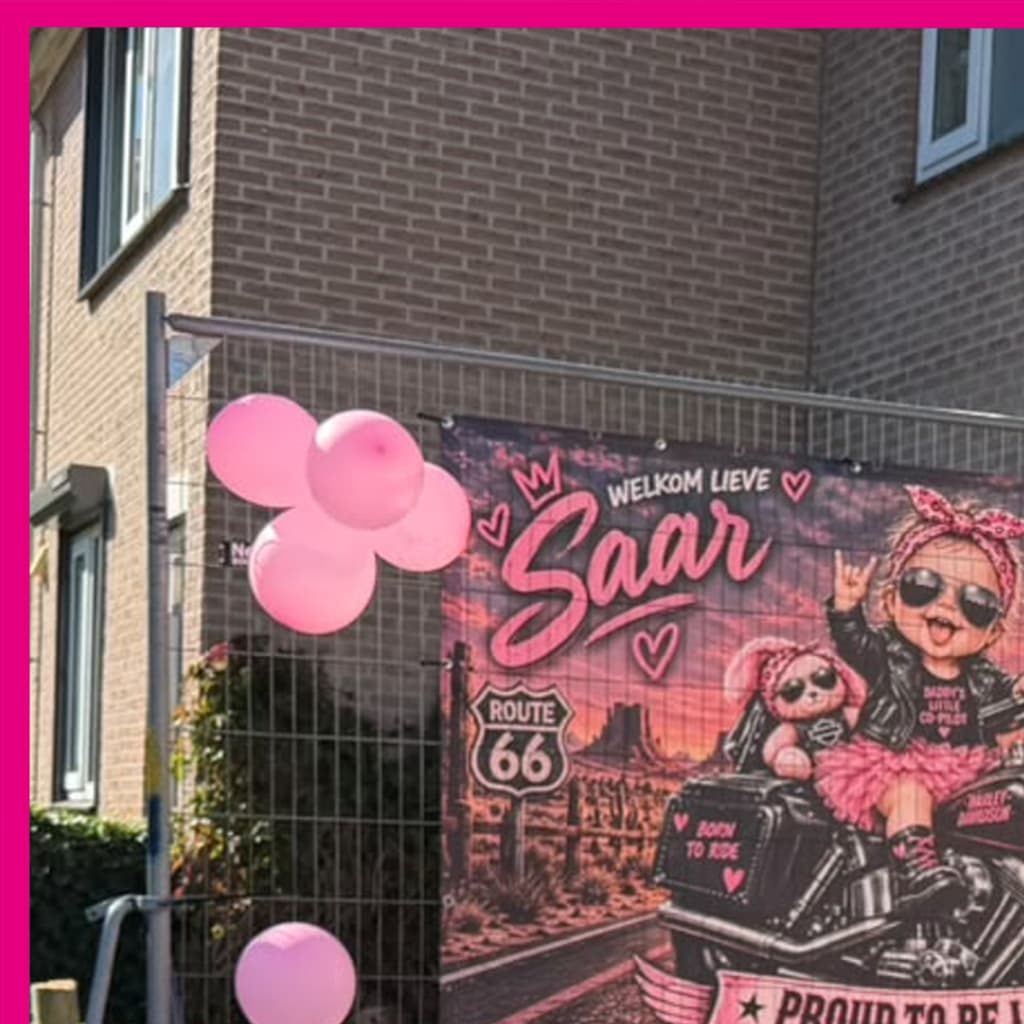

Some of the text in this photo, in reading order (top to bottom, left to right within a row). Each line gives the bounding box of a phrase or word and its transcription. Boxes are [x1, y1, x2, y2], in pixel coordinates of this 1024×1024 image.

[607, 467, 771, 507] WELKOM LIEVE
[491, 490, 773, 668] Saar
[489, 699, 556, 724] ROUTE
[490, 733, 552, 783] 66
[696, 820, 737, 839] BORN
[686, 841, 741, 861] TO RIDE
